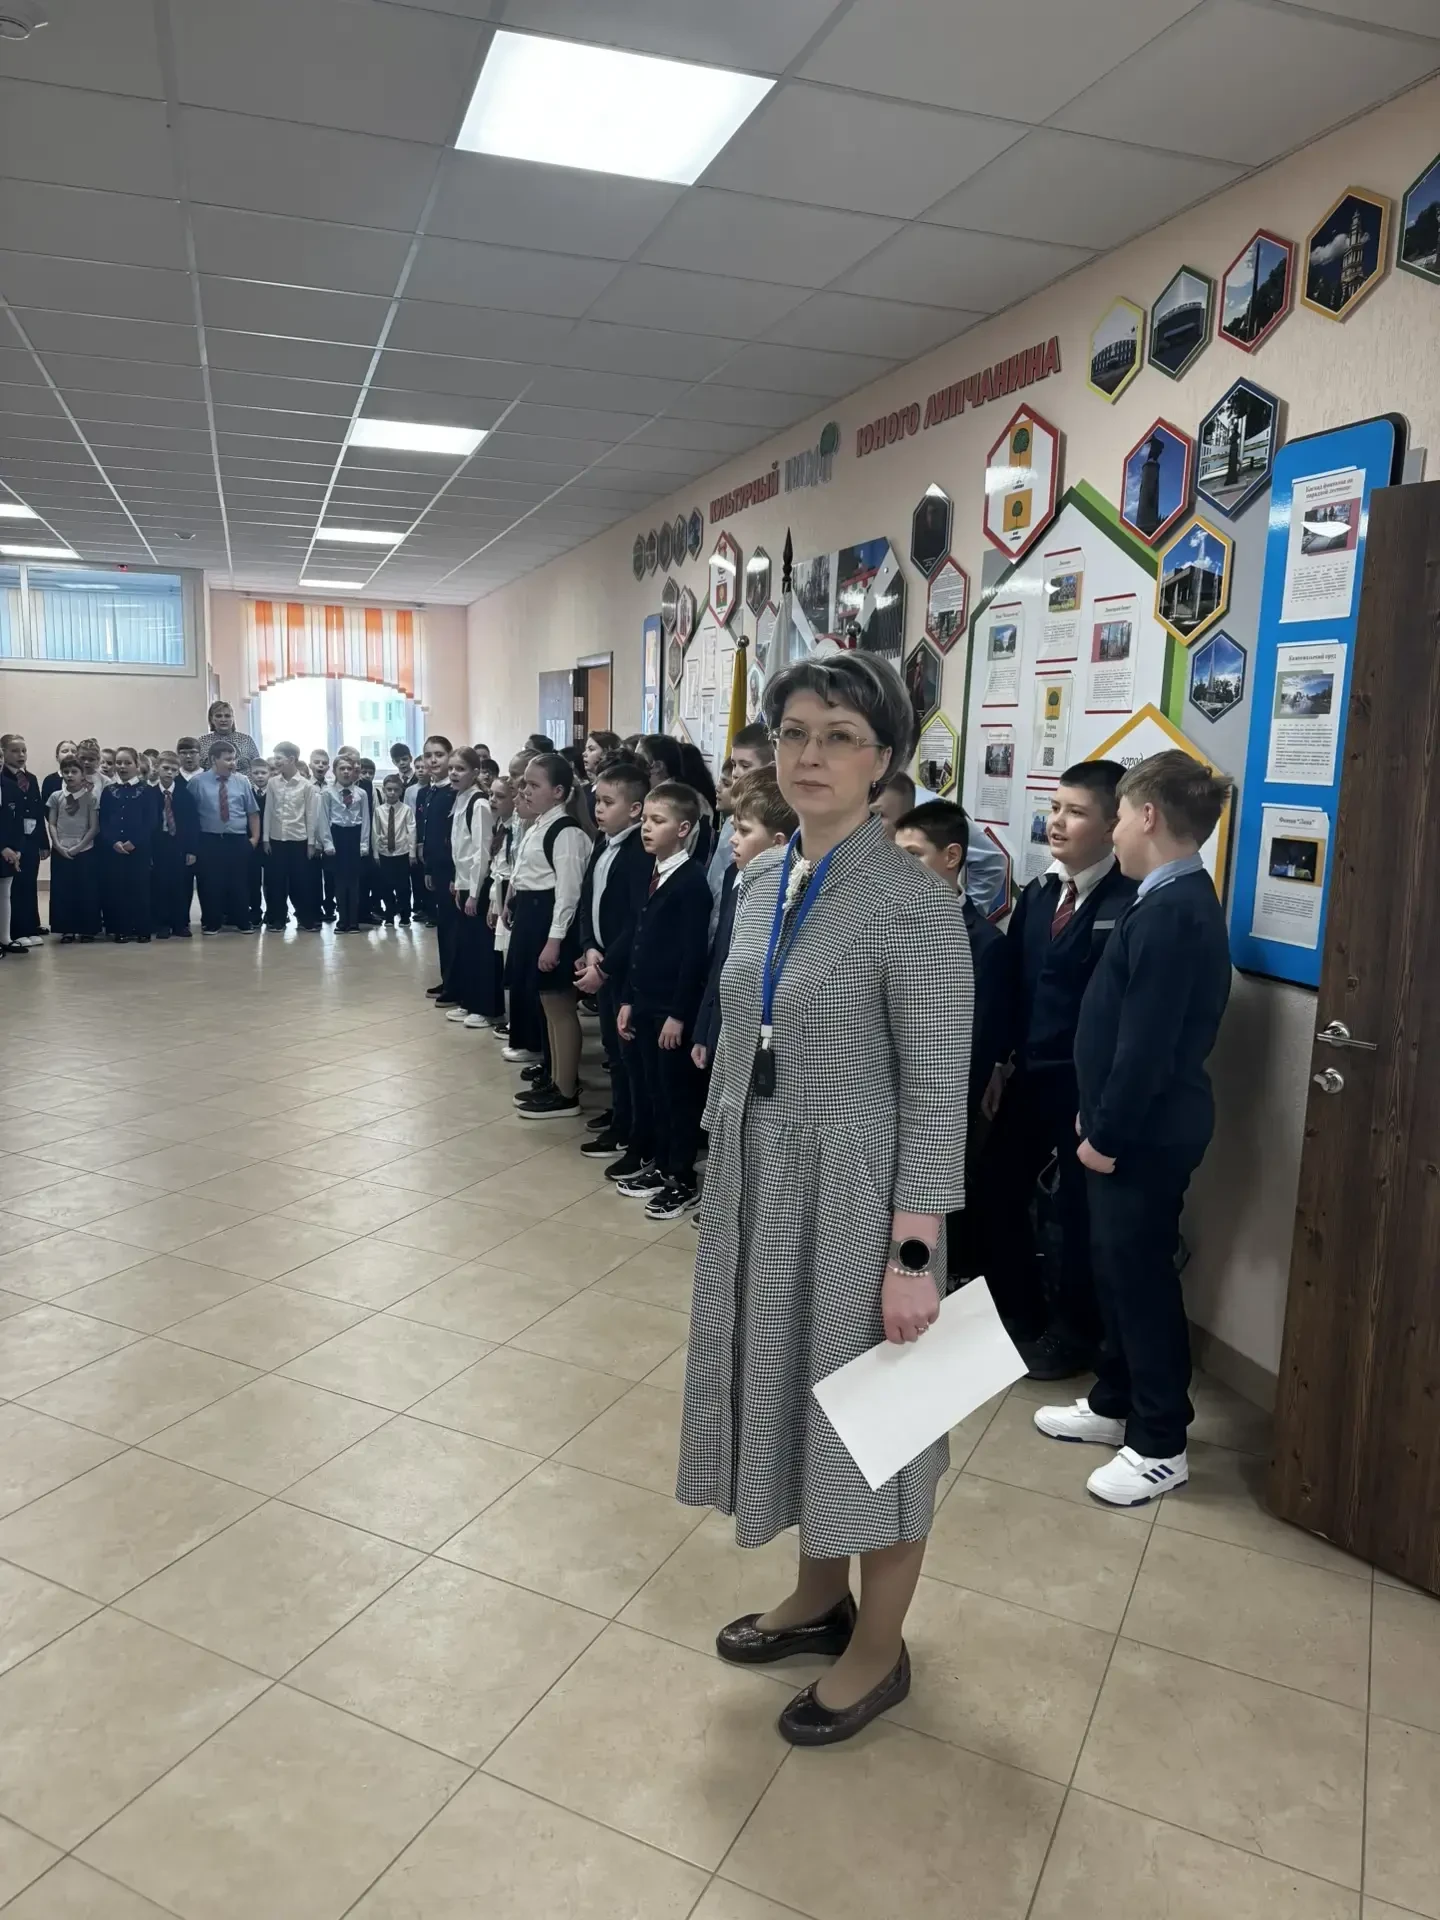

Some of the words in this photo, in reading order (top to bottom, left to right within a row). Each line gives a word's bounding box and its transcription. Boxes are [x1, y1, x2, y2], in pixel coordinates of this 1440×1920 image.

[709, 460, 780, 524] КУЛЬТУРНЫЙ
[856, 402, 921, 457] ЮНОГО
[923, 336, 1061, 429] ЛИПЧАНИНА
